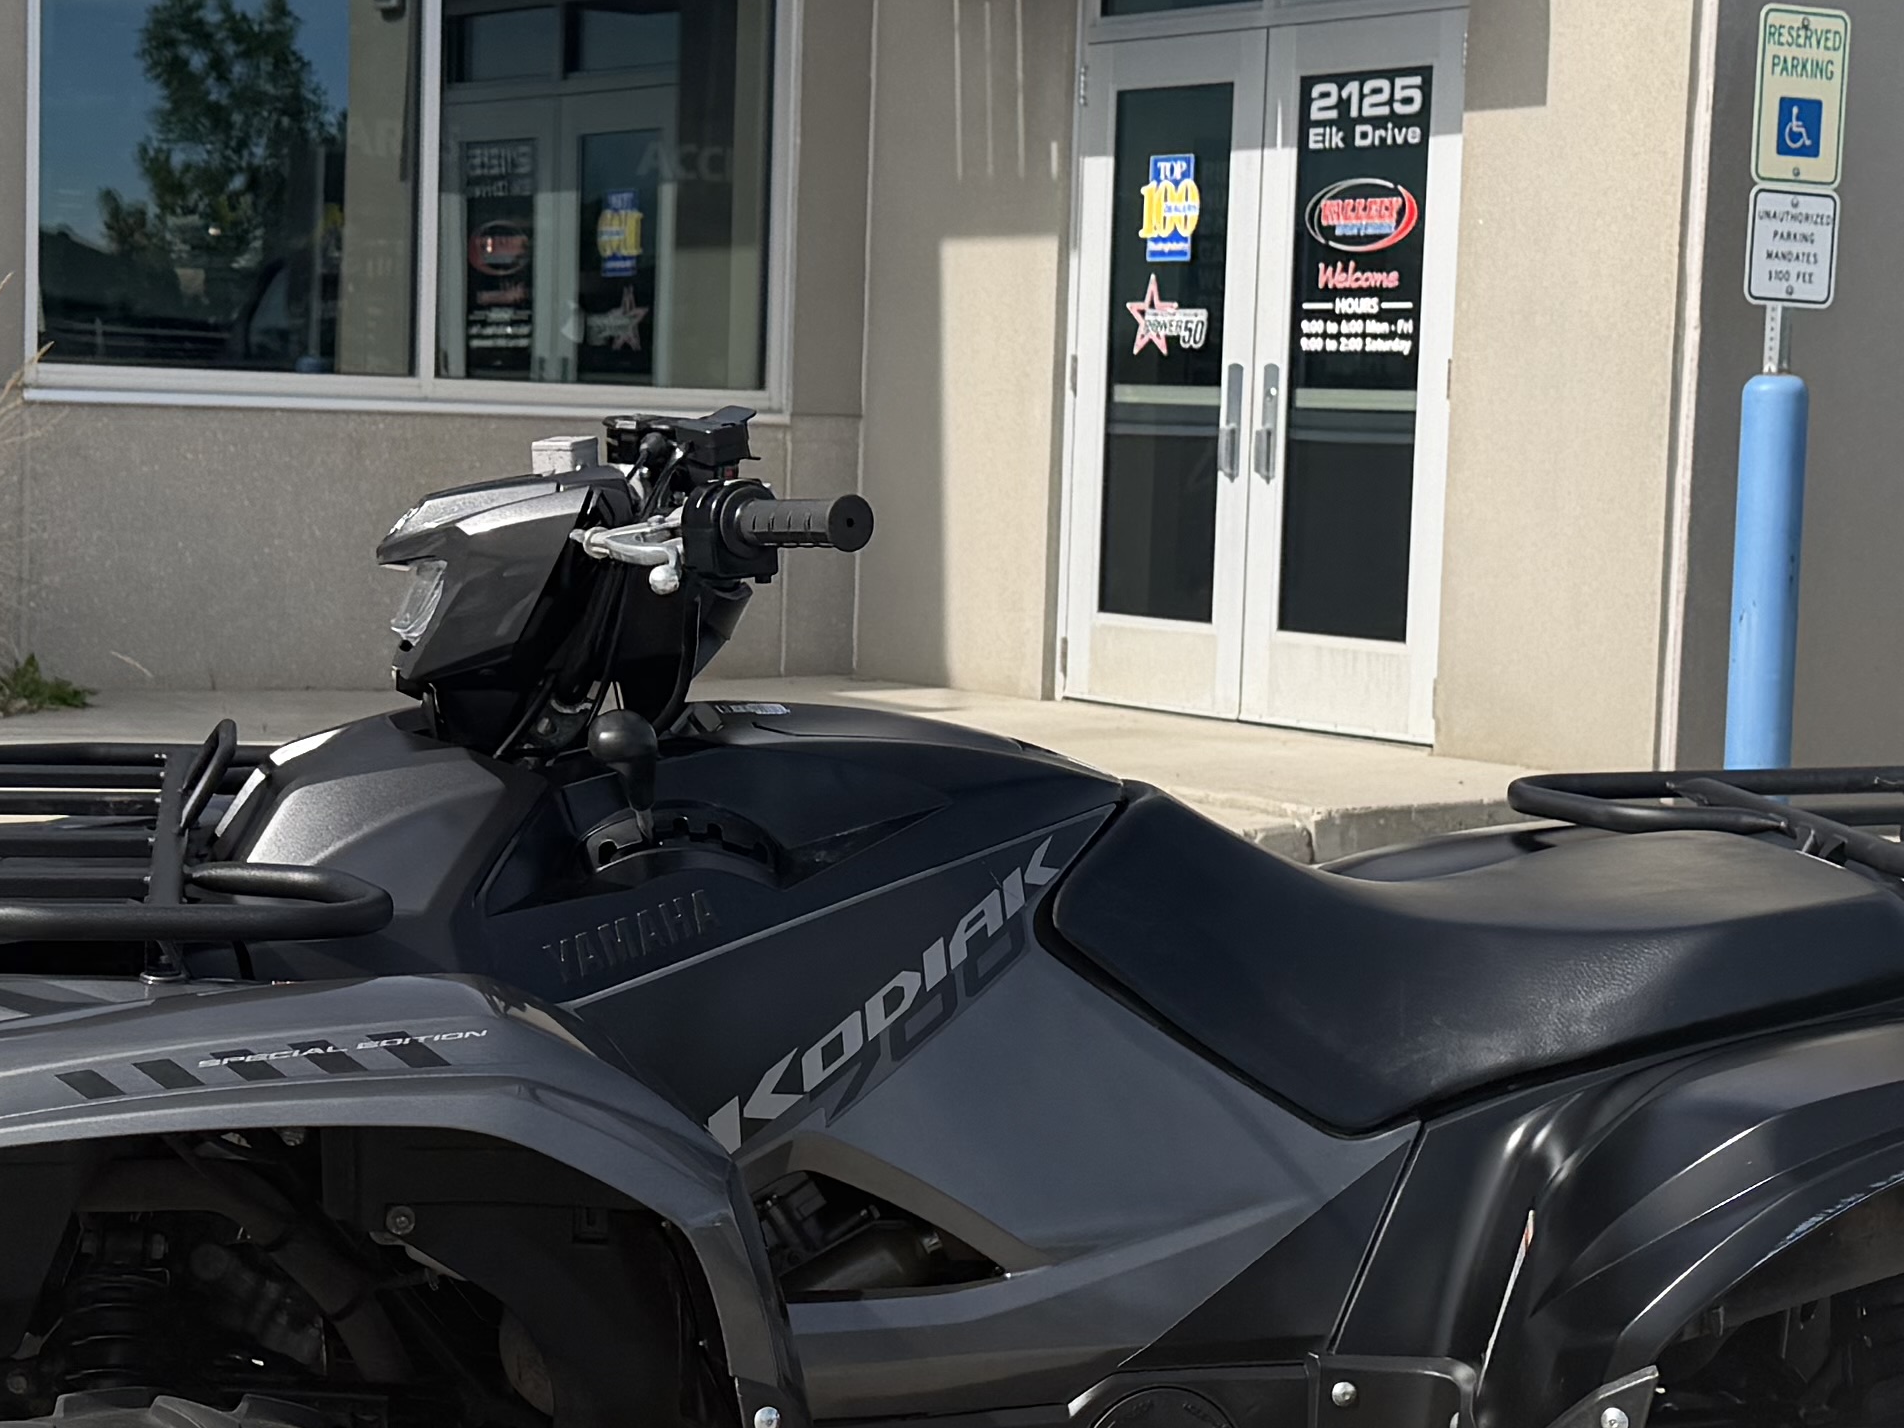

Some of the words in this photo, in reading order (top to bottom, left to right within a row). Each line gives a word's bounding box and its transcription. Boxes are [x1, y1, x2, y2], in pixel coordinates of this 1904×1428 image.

[1767, 23, 1842, 52] RESERVED
[1771, 53, 1834, 81] PARKING
[1310, 76, 1423, 121] 2125
[1308, 125, 1345, 149] Elk
[1354, 121, 1422, 147] Drive
[1157, 160, 1188, 181] TOP
[1138, 178, 1201, 239] 100
[1758, 210, 1833, 226] UNAUTHORIZED
[1773, 230, 1815, 245] PARKING
[1766, 249, 1818, 265] MANDATES
[1318, 260, 1400, 289] Welcome
[1335, 297, 1380, 314] HOURS
[1182, 319, 1205, 345] 50
[542, 887, 722, 983] YAMAHA
[705, 835, 1061, 1155] KODIAK
[198, 1045, 349, 1068] SPECIAL
[356, 1029, 488, 1050] EDITION
